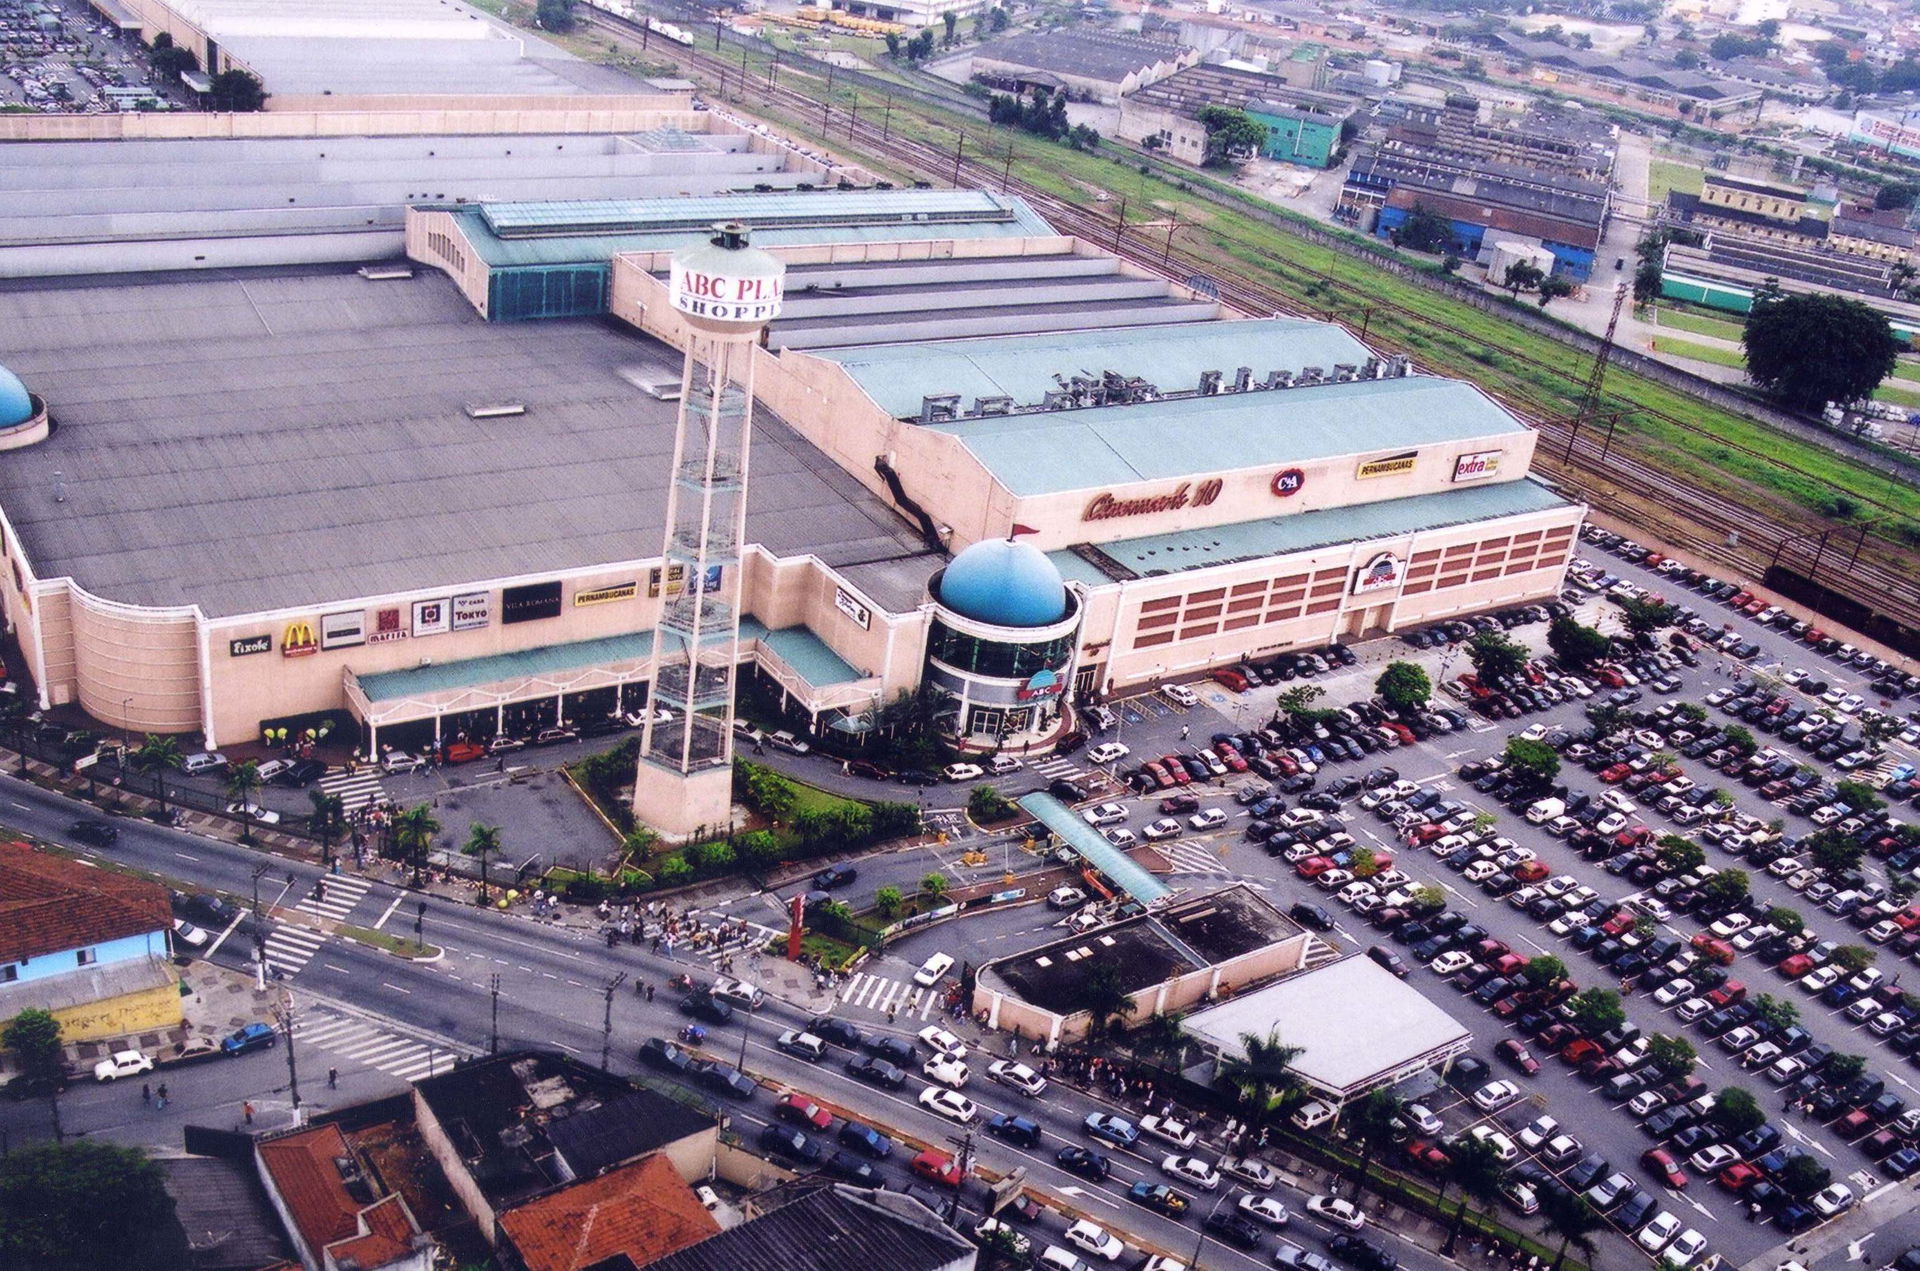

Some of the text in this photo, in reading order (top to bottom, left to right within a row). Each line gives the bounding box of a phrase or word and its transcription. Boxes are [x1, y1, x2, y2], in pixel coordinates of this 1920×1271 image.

[681, 271, 726, 299] ABC
[1361, 460, 1413, 476] PERNAMBUCANAS
[1458, 456, 1485, 475] extra
[577, 588, 635, 604] PERNAMBUCANAS
[455, 609, 488, 621] TOKYO
[1031, 686, 1051, 697] ABC
